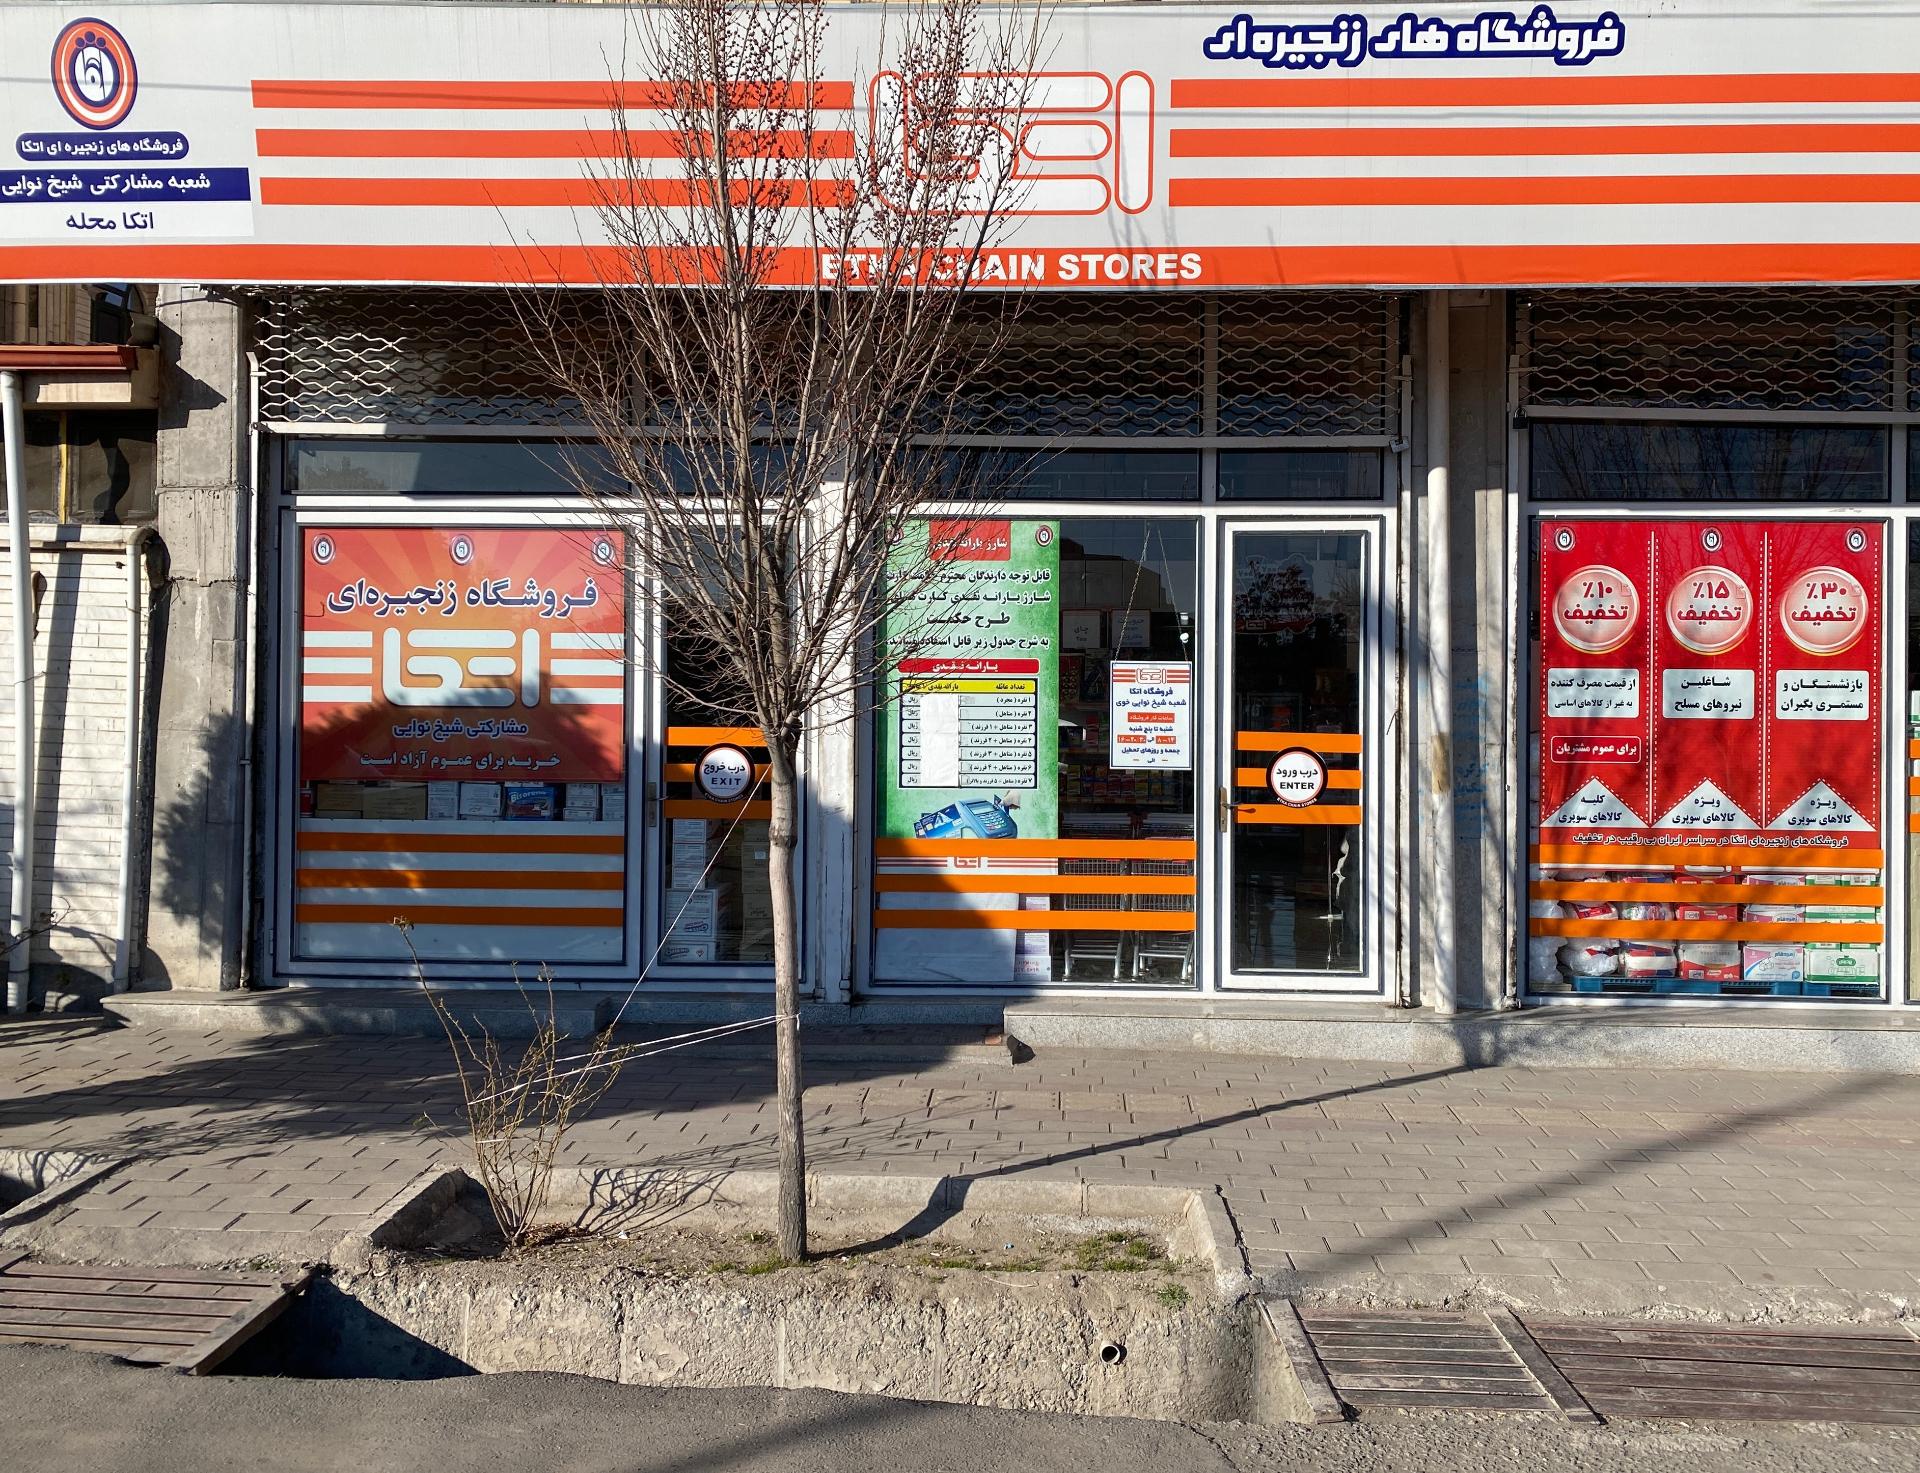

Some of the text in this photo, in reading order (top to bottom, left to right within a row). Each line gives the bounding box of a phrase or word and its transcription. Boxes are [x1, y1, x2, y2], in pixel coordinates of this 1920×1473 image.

[1207, 10, 1622, 64] فروشگاه های زنجیره ای
[20, 138, 184, 155] فروشگاه های زنجیره ای اتکا
[1, 173, 211, 198] شعبه مشارکتی شیخ نوایی
[66, 211, 155, 230] اتکا محله
[933, 254, 1046, 280] CHAIN
[1057, 253, 1202, 280] STORES
[968, 570, 1007, 585] دارندگان
[1008, 571, 1030, 584] توجه
[1031, 569, 1051, 584] قابل
[465, 577, 599, 618] فروشگاه
[917, 591, 948, 604] کارت
[950, 590, 981, 604] نقدی
[982, 591, 1020, 605] یارانه
[926, 611, 1010, 628] طرح حکمت
[1563, 604, 1629, 625] تخفیف
[1676, 605, 1742, 626] تخفیف
[1790, 606, 1858, 627] تخفیف
[953, 635, 972, 650] قابل
[973, 638, 988, 649] زیر
[990, 636, 1016, 648] جدول
[1018, 637, 1038, 648] شرح
[1040, 638, 1049, 648] به
[931, 660, 999, 673] یارانه نقدی
[1550, 677, 1636, 691] از قیمت مصرف کننده
[1680, 675, 1732, 690] شاغلین
[1783, 679, 1864, 693] بازنشستگان و
[1129, 686, 1174, 697] فروشگاه اتکا
[1116, 698, 1187, 709] شعبه شیخ نوایی خوی
[1554, 699, 1577, 709] اساسی
[1577, 699, 1604, 709] کالاهای
[1605, 699, 1612, 708] از
[1613, 700, 1625, 708] غیر
[1674, 698, 1743, 712] نیروهای مسلح
[1780, 698, 1864, 712] مستمری بگیران
[392, 719, 529, 742] مشارکتی شیخ نوایی
[1128, 725, 1143, 733] شنبه
[1121, 747, 1140, 755] تعطیل
[1555, 743, 1638, 757] برای عموم مشتریان
[359, 749, 561, 771] خرید برای عموم آزاد است
[703, 761, 746, 775] درب خروج
[1276, 768, 1319, 779] درب ورود
[711, 777, 742, 786] EXIT
[1279, 781, 1315, 790] ENTER
[1580, 794, 1606, 806] کلیه
[1694, 796, 1721, 808] ویژه
[1810, 797, 1838, 810] ویژه
[1558, 811, 1623, 824] کالاهای سوپری
[1672, 812, 1736, 825] کالاهای سوپری
[1787, 814, 1853, 826] کالاهای سوپری
[1572, 833, 1603, 845] تخفیف
[1603, 834, 1616, 845] در
[1617, 835, 1643, 847] رقیب
[1646, 836, 1658, 846] بی
[1658, 834, 1683, 847] ایران
[1683, 835, 1717, 846] سراسر
[1719, 837, 1730, 847] در
[1731, 835, 1748, 845] اتکا
[1791, 835, 1810, 848] های
[1809, 834, 1849, 848] فروشگاه
